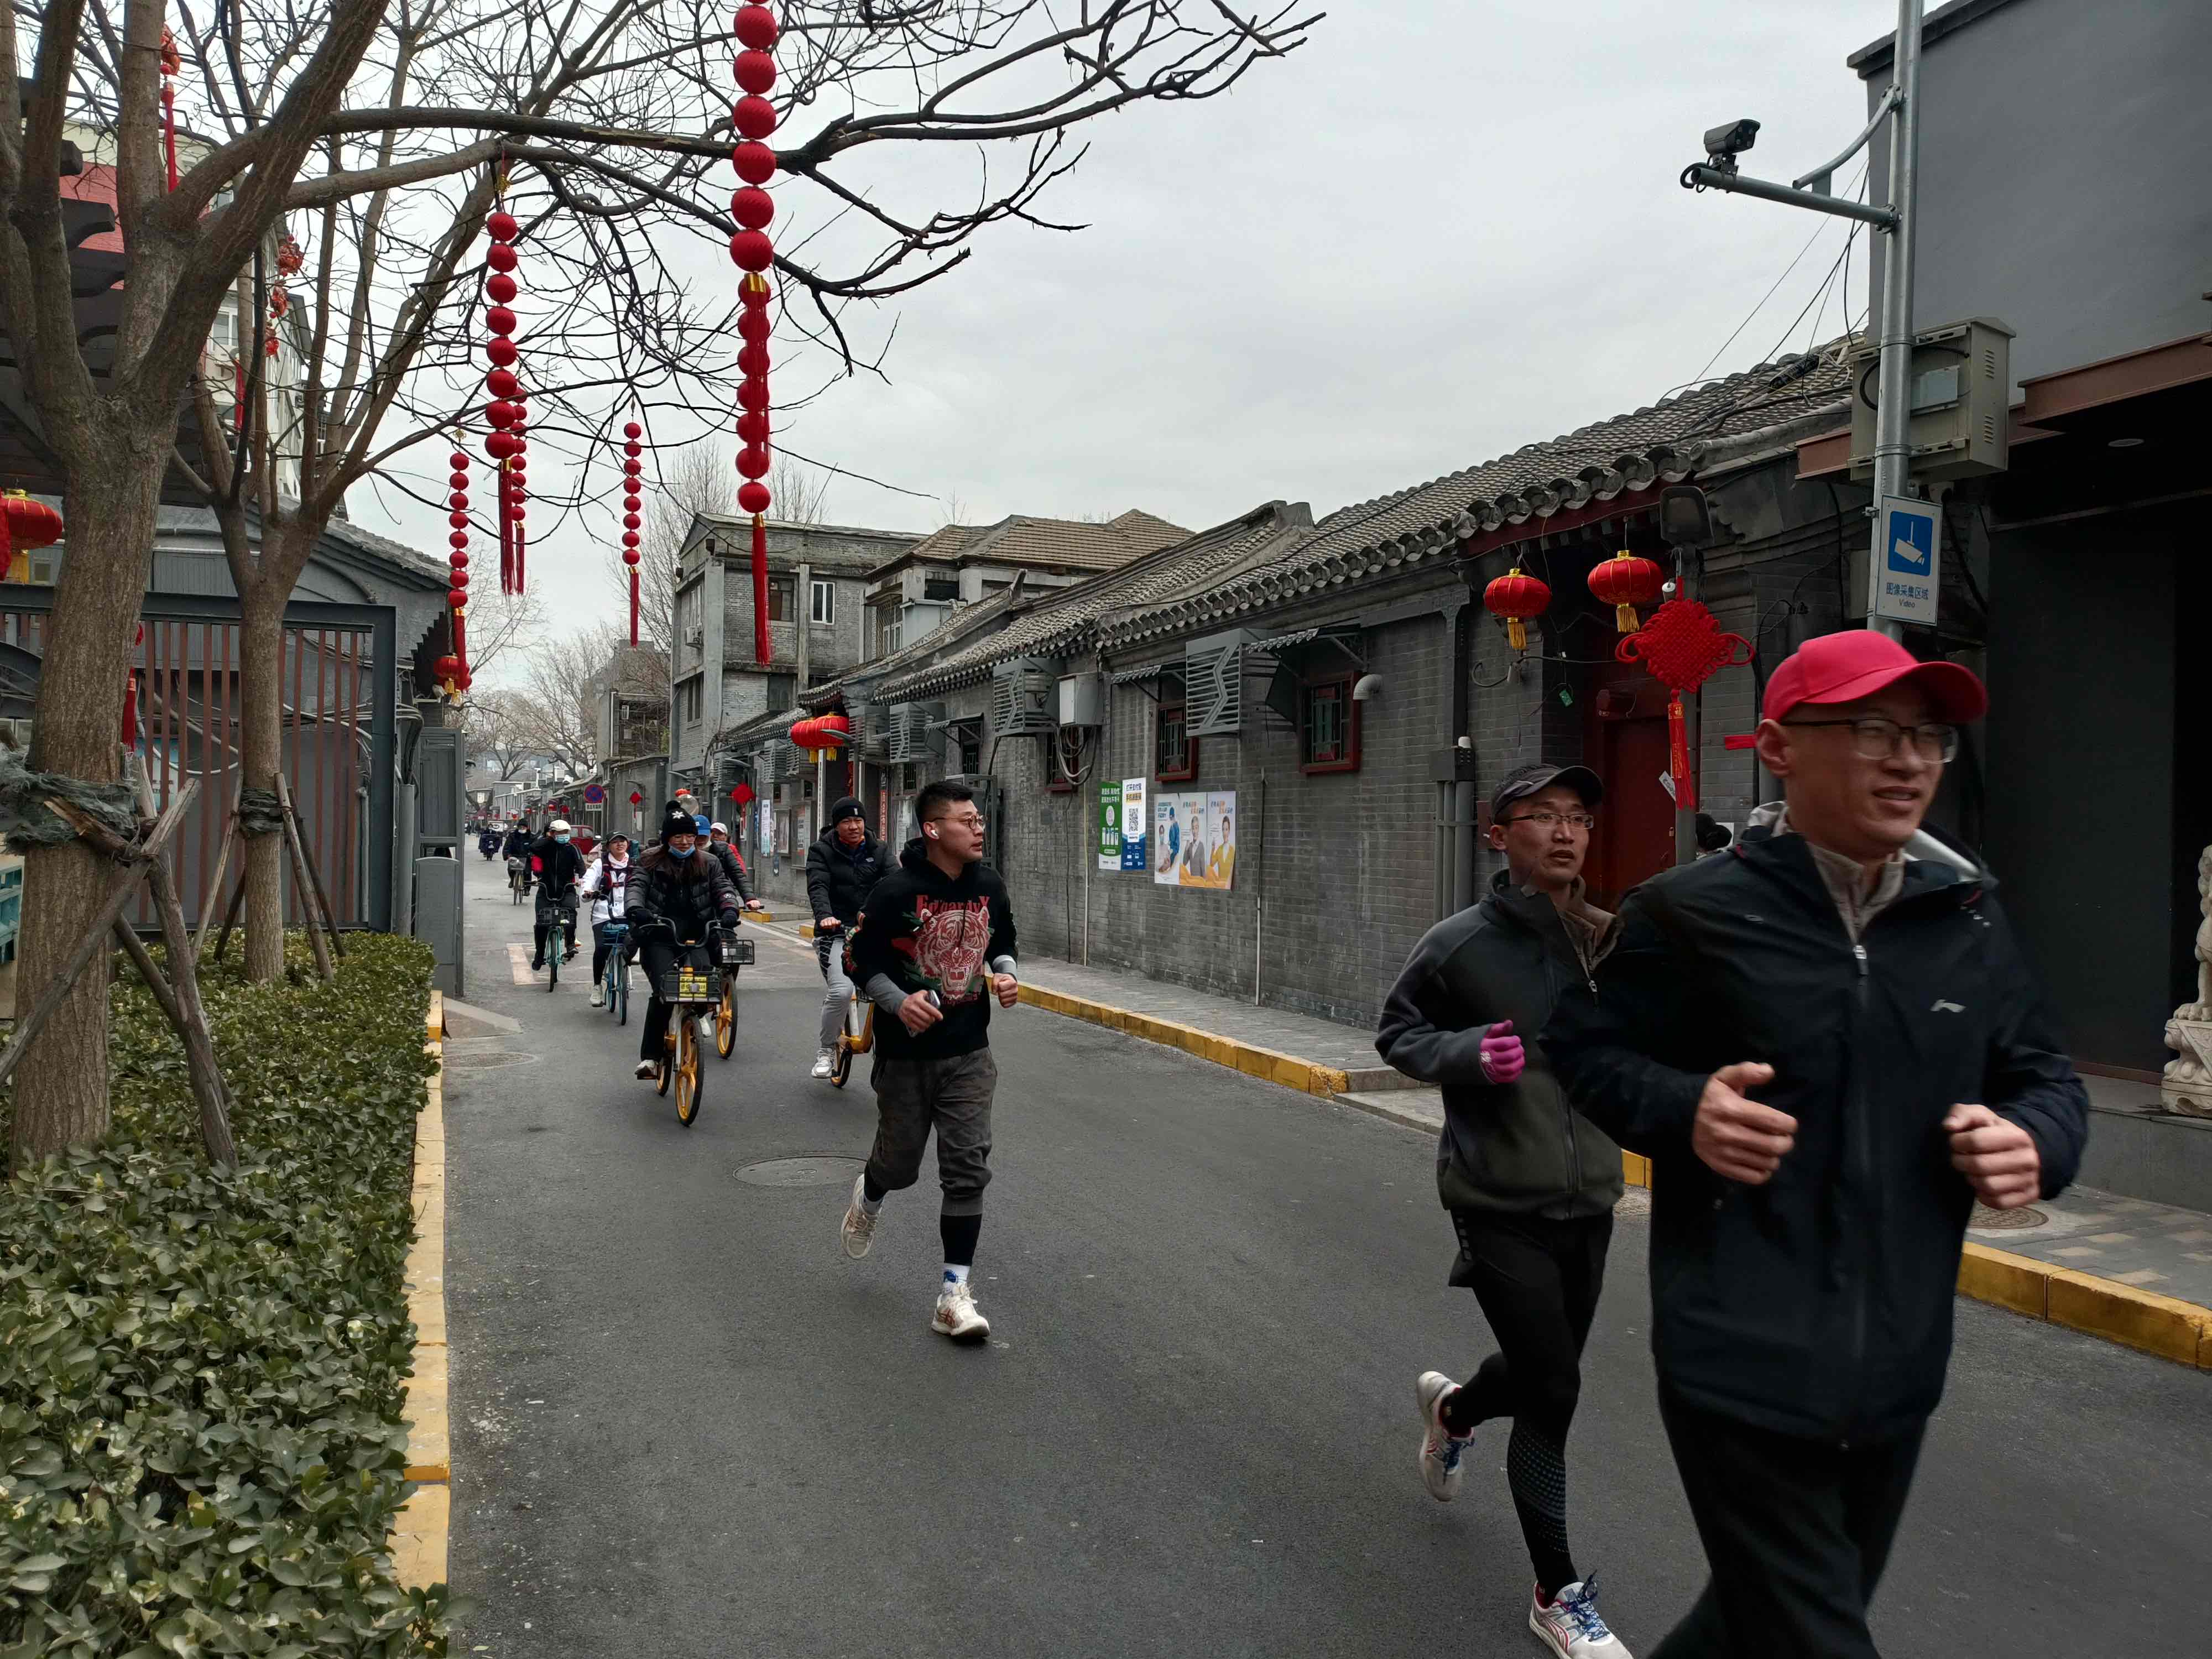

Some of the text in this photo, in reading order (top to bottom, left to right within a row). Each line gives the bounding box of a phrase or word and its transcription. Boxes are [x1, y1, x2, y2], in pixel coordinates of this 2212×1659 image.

[1886, 582, 1928, 599] 图像采集区域
[1899, 598, 1915, 608] Video
